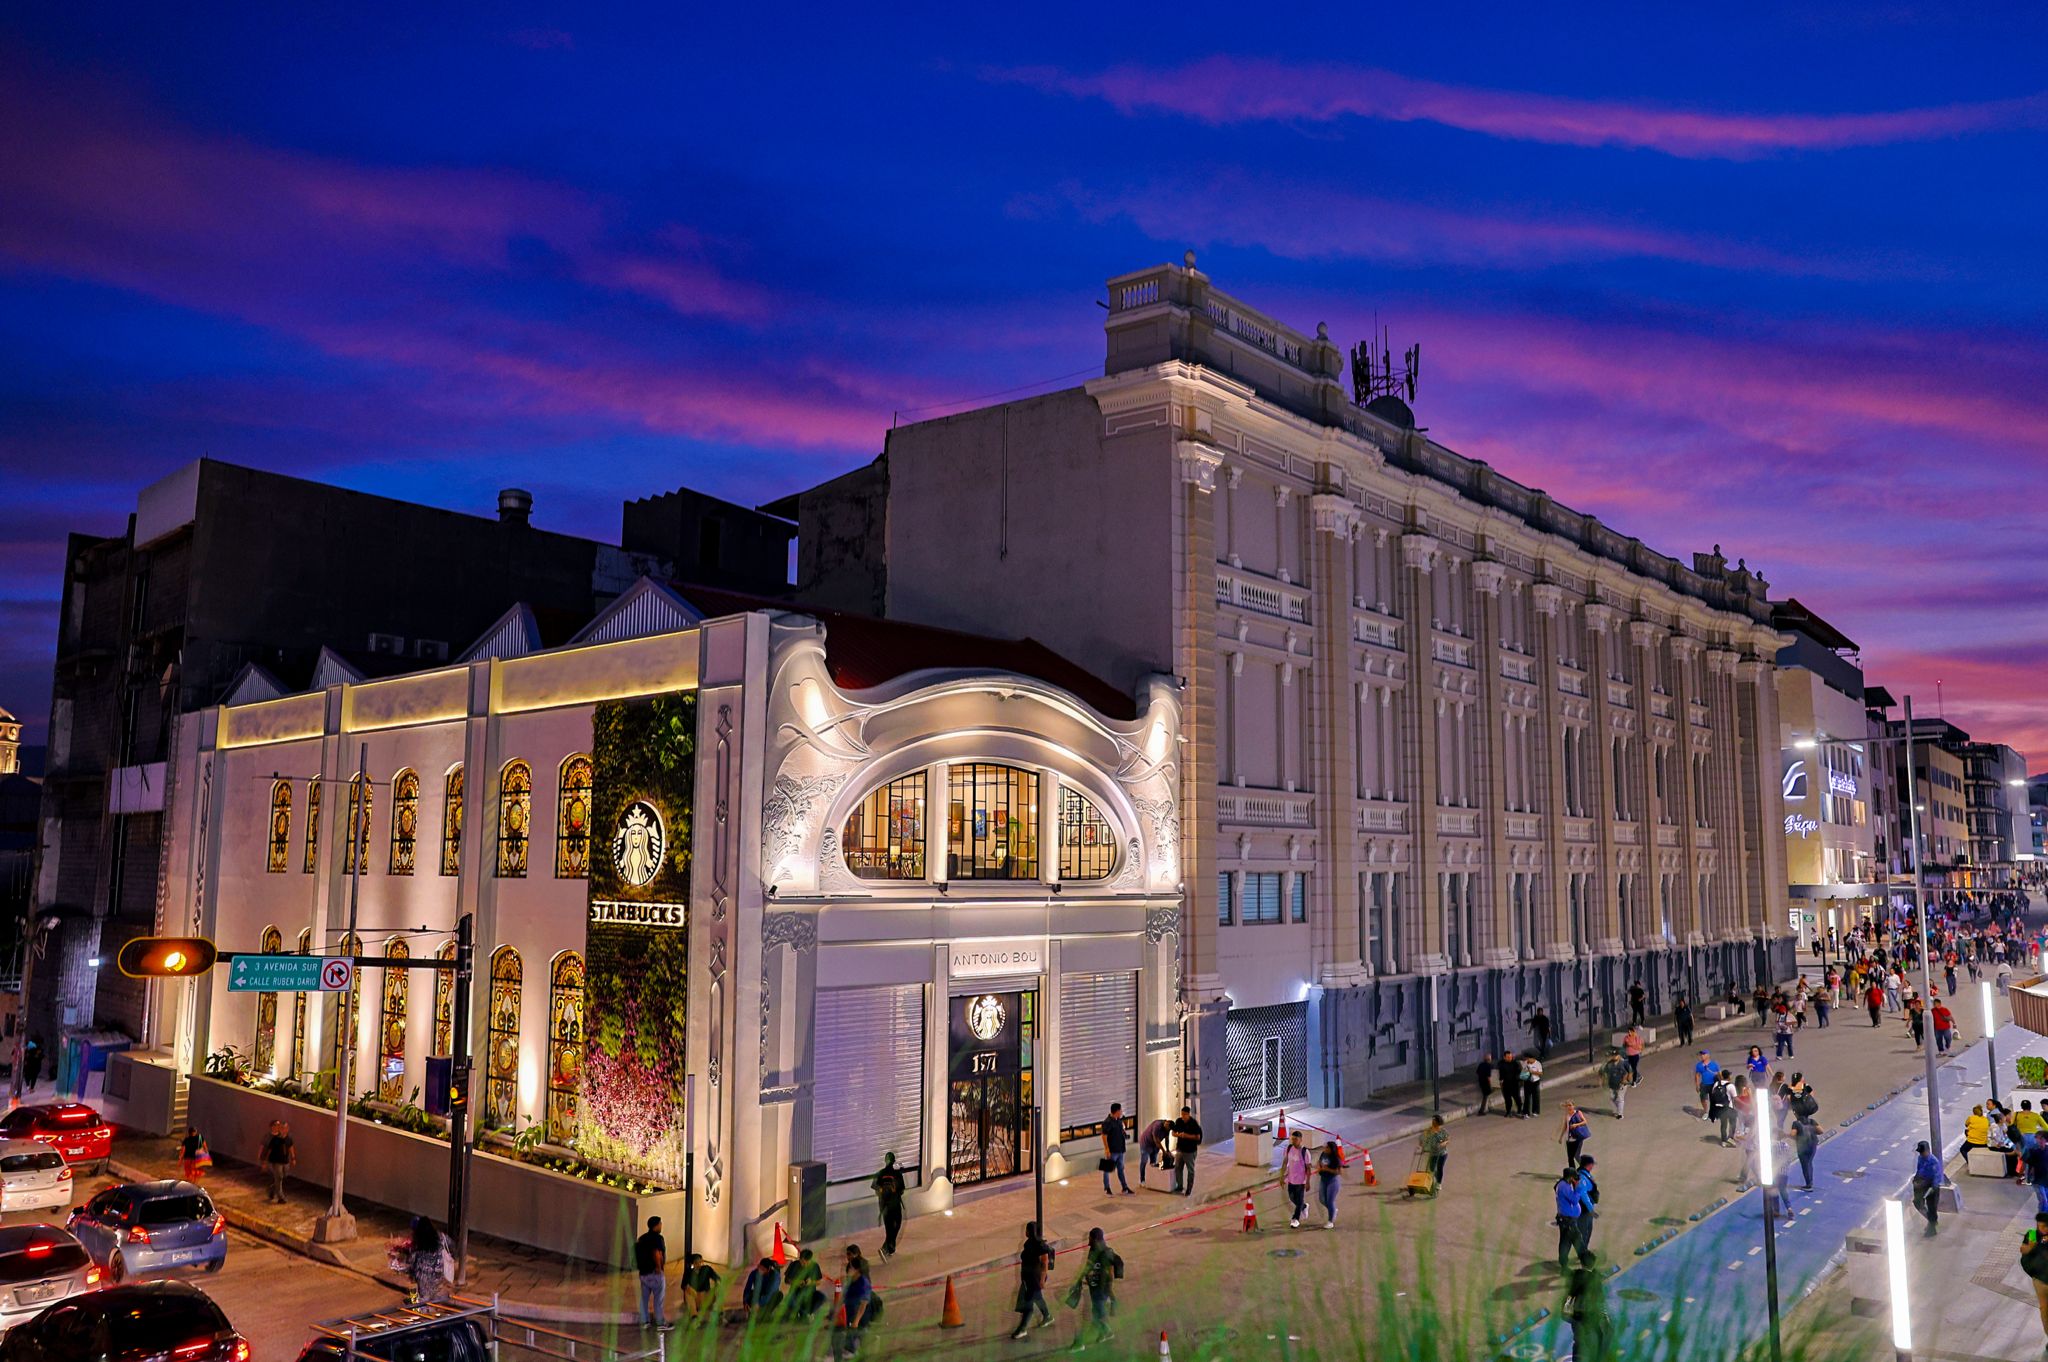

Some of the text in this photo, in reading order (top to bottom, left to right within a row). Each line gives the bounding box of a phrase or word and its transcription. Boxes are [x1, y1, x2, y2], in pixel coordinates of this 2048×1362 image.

[589, 903, 681, 924] STARBUCKS
[953, 951, 1037, 966] ANTONIO BOU
[254, 962, 318, 972] 3 AVENIDA SUR
[249, 978, 317, 987] CALLE RUBEN DARIO
